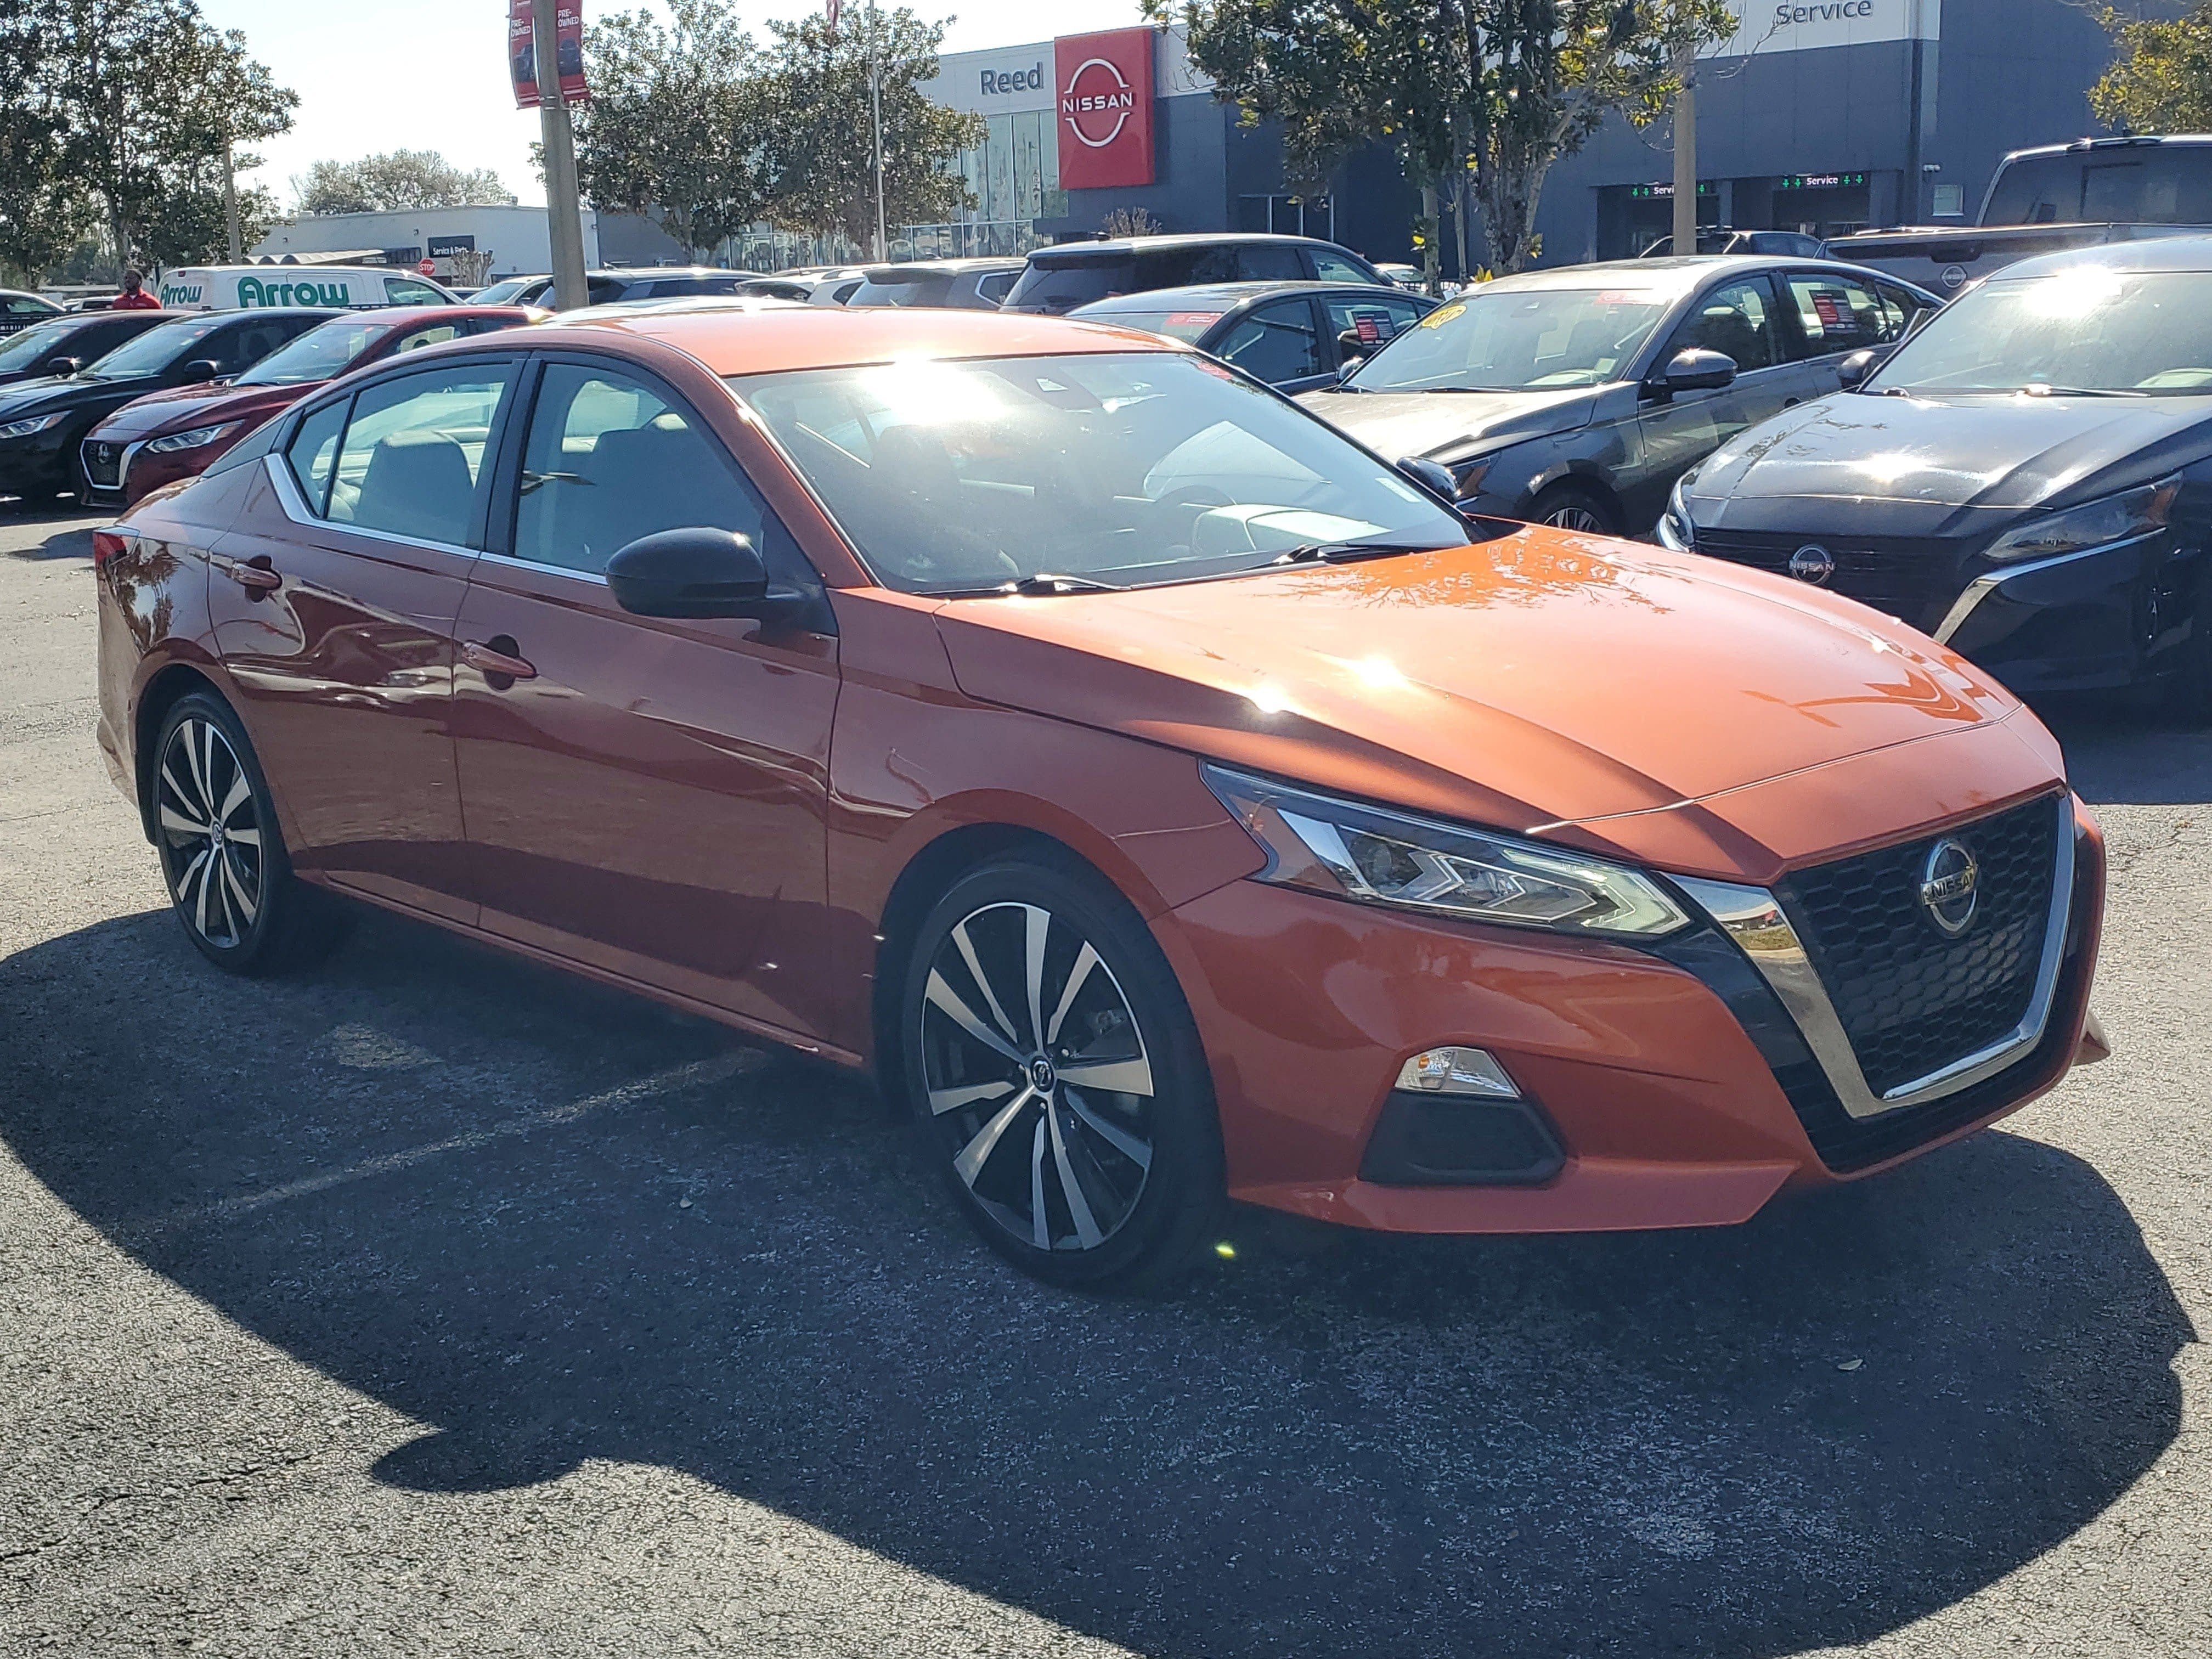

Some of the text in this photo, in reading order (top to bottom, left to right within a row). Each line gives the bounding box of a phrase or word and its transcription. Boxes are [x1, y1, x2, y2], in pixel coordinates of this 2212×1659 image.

[557, 9, 572, 19] PRE-
[1776, 0, 1872, 25] Service
[557, 16, 579, 27] OWNED
[980, 61, 1043, 95] Reed
[1062, 92, 1132, 113] NISSAN
[1807, 174, 1838, 185] Service
[1654, 185, 1674, 195] Servi
[161, 283, 202, 309] Arrow
[238, 276, 349, 308] Arrow
[1790, 562, 1834, 571] NISSAN
